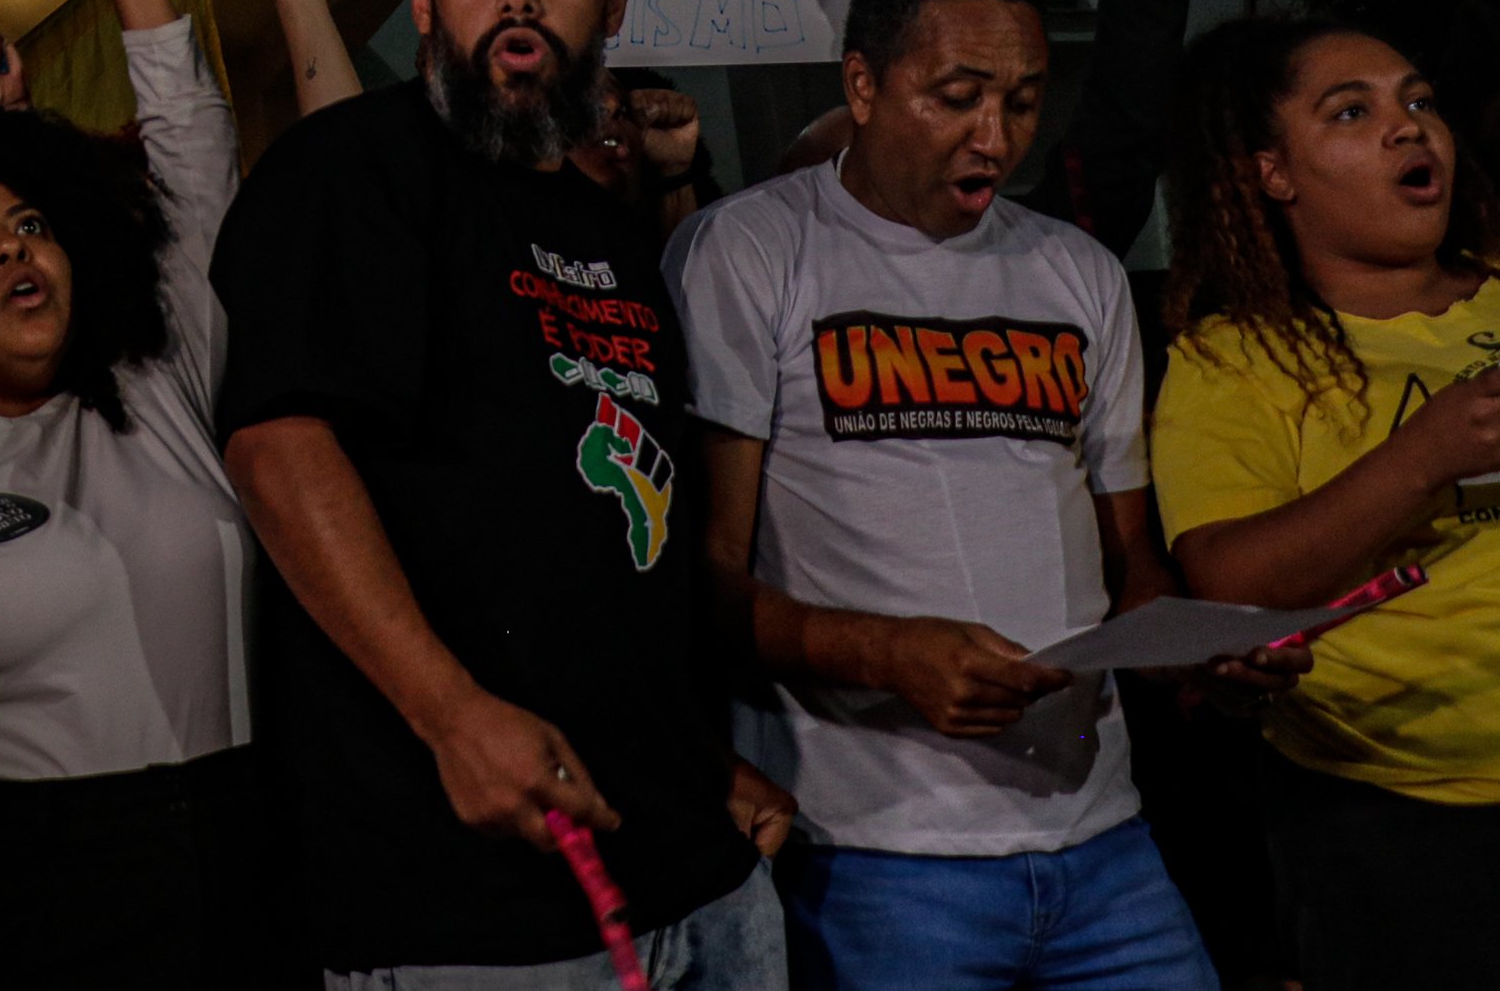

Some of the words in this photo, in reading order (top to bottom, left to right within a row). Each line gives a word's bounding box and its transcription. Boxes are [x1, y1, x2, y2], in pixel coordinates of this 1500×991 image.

[817, 324, 1089, 424] UNEGRO
[834, 412, 876, 434] UNIÃO
[879, 412, 897, 431] DE
[900, 411, 951, 430] NEGRAS
[954, 411, 964, 429] E
[966, 410, 1016, 431] NEGROS
[1015, 413, 1043, 433] PELA
